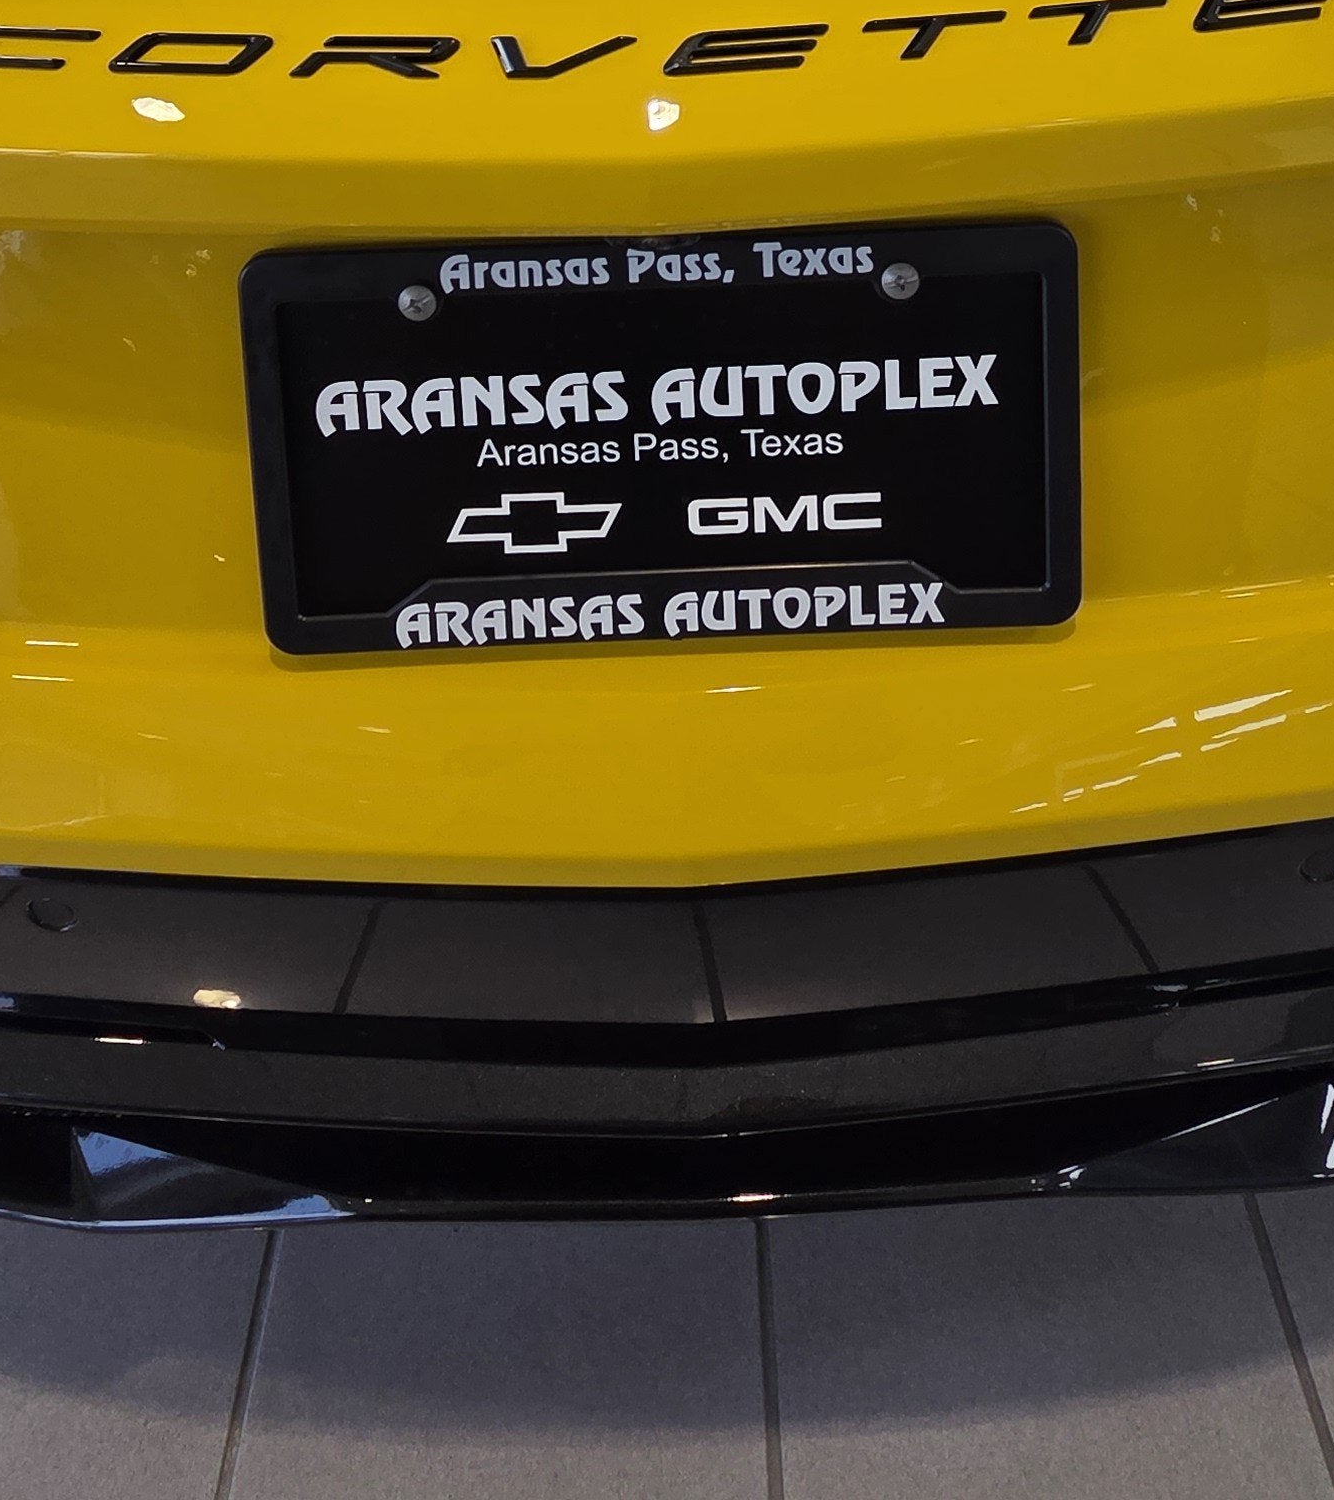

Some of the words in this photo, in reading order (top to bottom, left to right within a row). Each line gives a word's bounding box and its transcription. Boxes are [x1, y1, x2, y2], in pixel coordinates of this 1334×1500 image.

[439, 254, 610, 294] Aransas
[626, 248, 735, 284] Pass,
[752, 241, 874, 278] Texas
[315, 370, 629, 438] ARANSAS
[650, 354, 999, 426] AUTOPLEX
[476, 438, 621, 468] Aransas
[633, 432, 729, 464] Pass,
[740, 428, 844, 458] Texas
[687, 491, 883, 536] GMC
[395, 593, 645, 649] ARANSAS
[663, 582, 945, 637] AUTOPLEX
